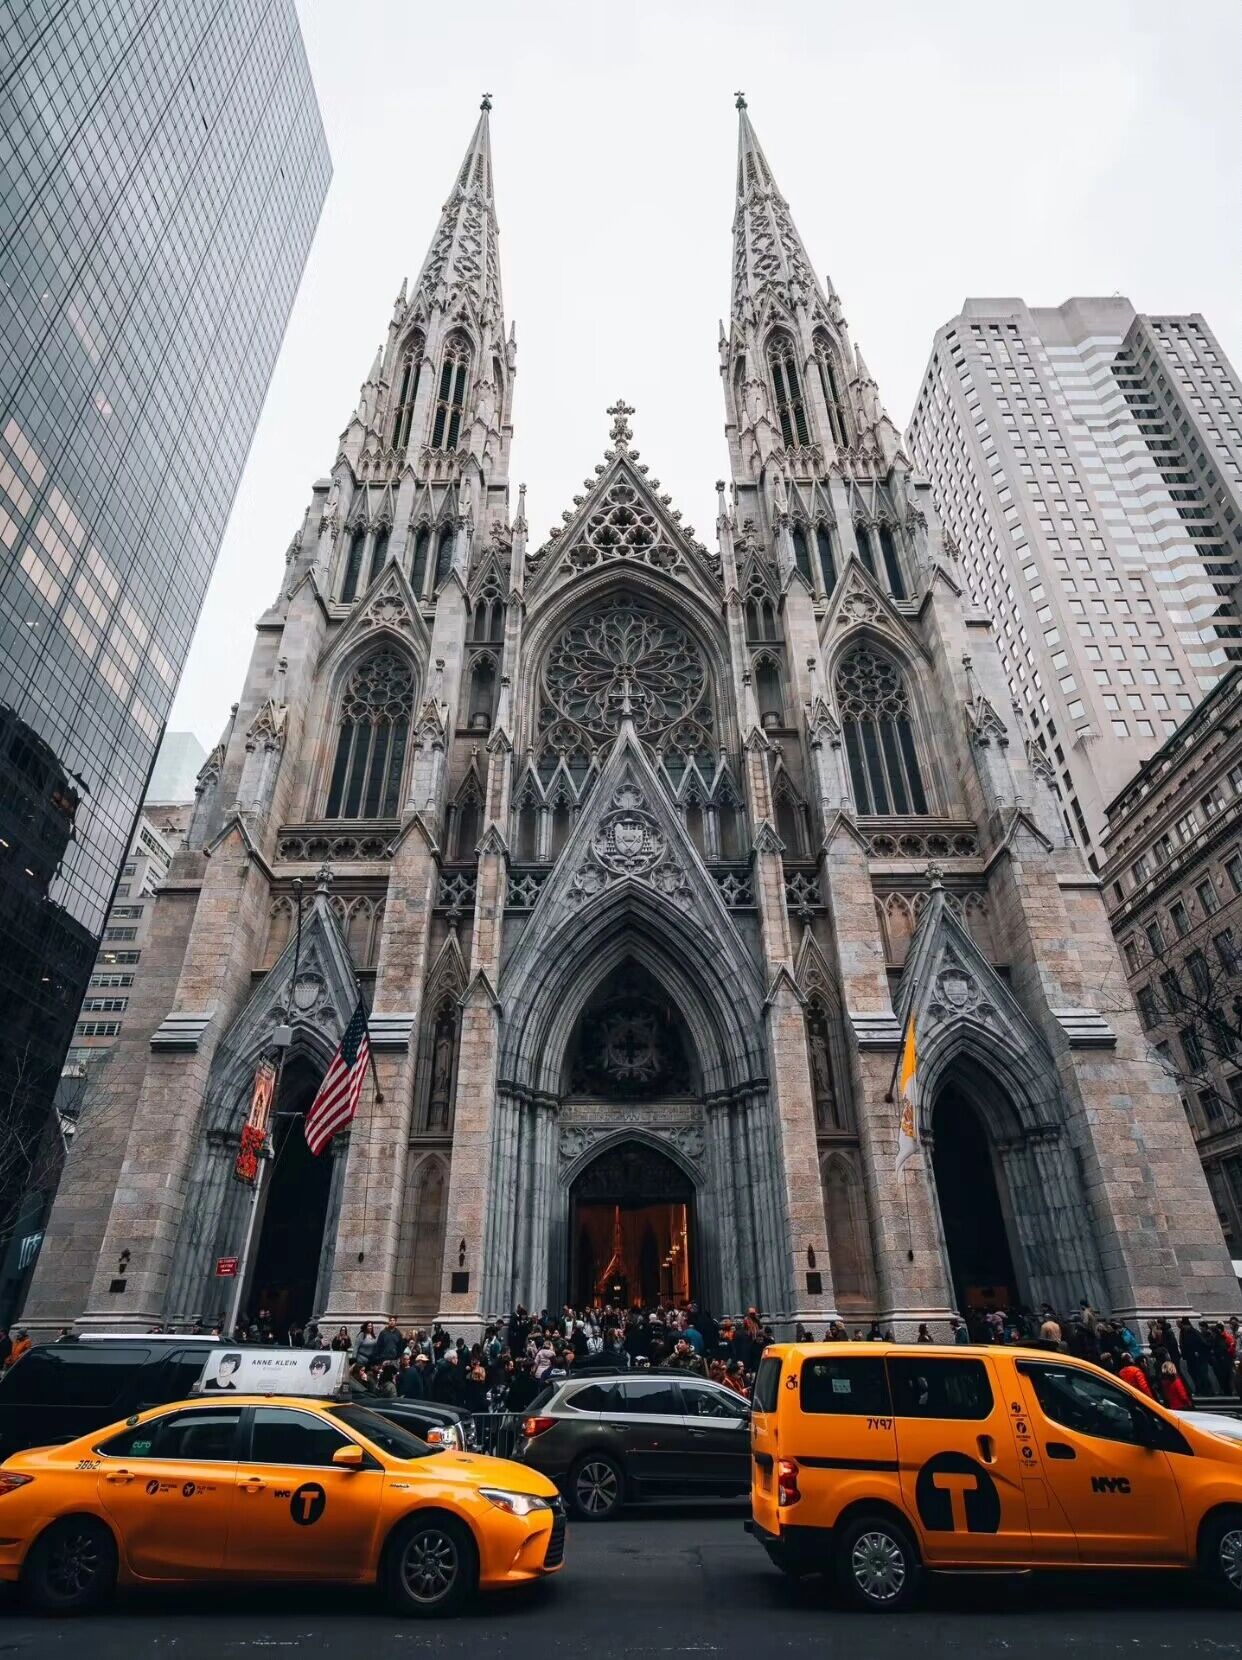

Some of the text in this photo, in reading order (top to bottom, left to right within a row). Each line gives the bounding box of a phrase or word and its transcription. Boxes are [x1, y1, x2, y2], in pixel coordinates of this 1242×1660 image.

[867, 1418, 892, 1430] 7Y97
[1090, 1476, 1131, 1494] NYC
[274, 1490, 291, 1498] NYC
